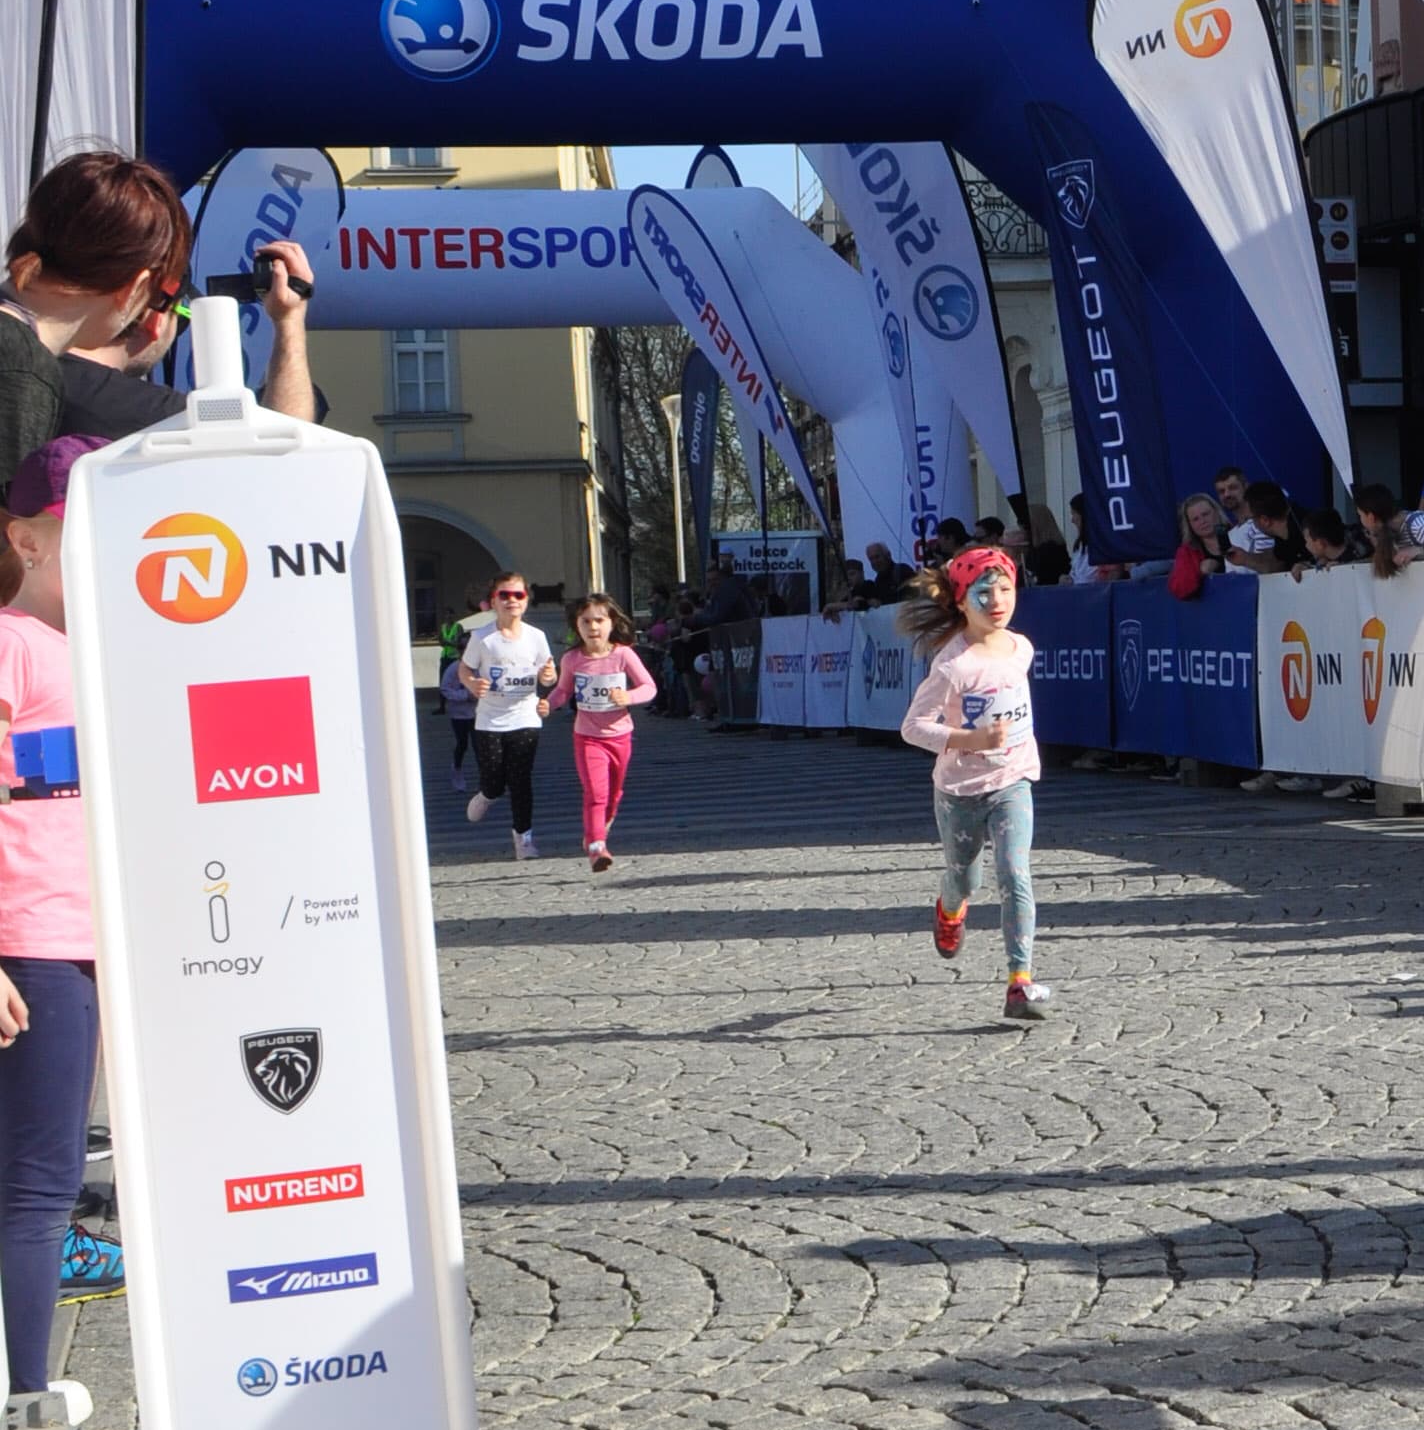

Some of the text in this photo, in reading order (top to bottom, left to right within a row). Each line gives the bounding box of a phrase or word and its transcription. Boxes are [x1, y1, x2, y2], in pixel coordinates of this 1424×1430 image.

[339, 226, 637, 271] INTERSPOR
[1072, 245, 1134, 532] PEUGEOT
[690, 391, 705, 464] gorenje
[268, 540, 346, 578] NN
[734, 558, 806, 571] hitchcock
[750, 545, 788, 557] lekce
[1033, 649, 1106, 680] EUGEOT
[1317, 654, 1342, 685] NN
[1390, 653, 1416, 688] NN
[208, 762, 305, 794] AVON
[304, 894, 360, 910] Powered
[304, 908, 360, 927] by MVM
[182, 954, 264, 976] innogy
[248, 1034, 314, 1049] PEUGEOT
[233, 1171, 358, 1205] NUTREND
[284, 1351, 388, 1387] ŠKODA
